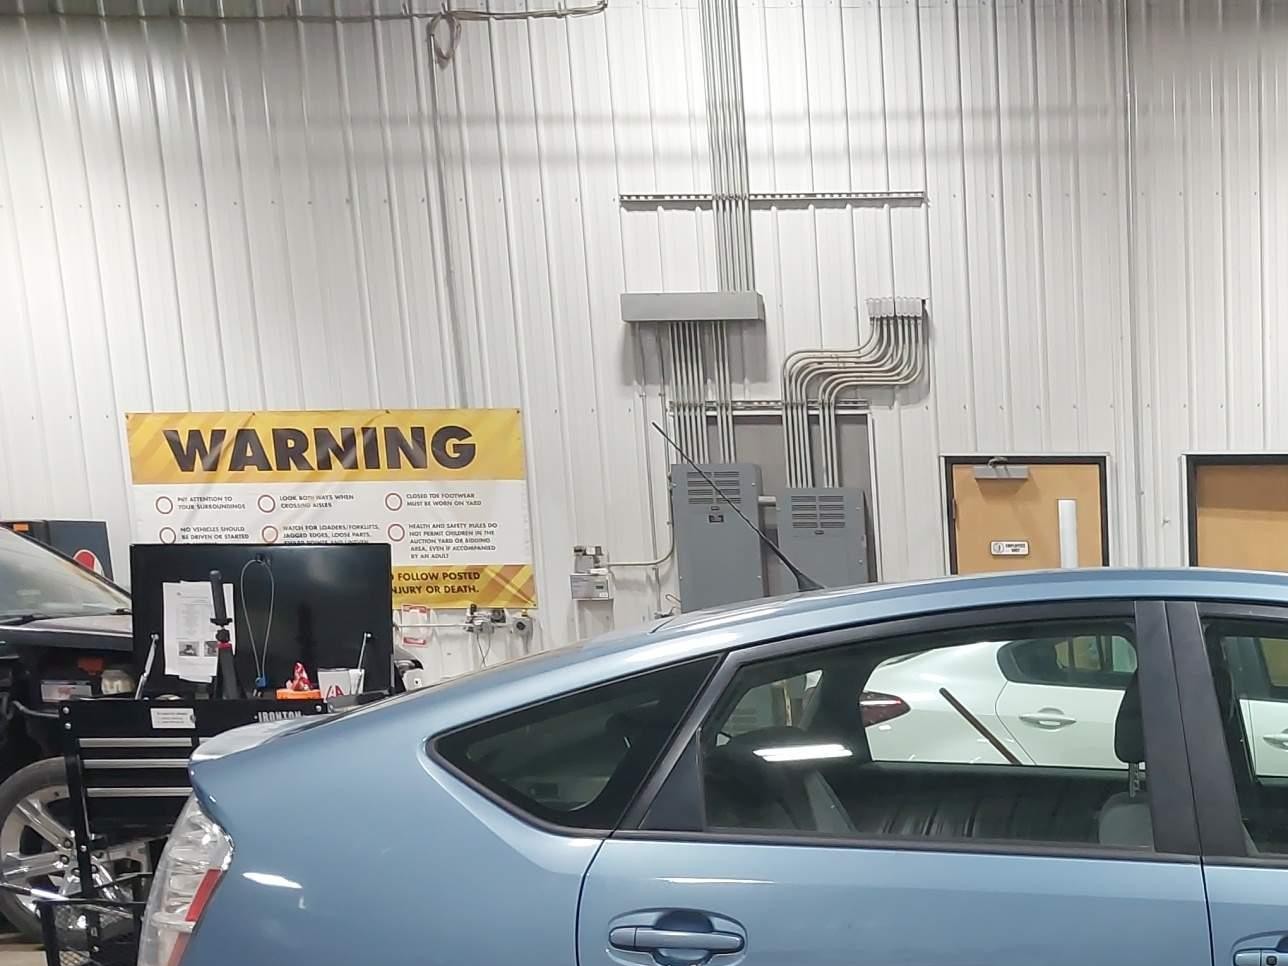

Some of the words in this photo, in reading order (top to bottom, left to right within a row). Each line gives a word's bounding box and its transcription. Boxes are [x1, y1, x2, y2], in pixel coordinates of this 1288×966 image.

[163, 426, 477, 472] WARNING
[398, 571, 439, 581] FOLLOW
[442, 572, 480, 580] POSTED
[426, 585, 440, 594] OR
[444, 585, 479, 594] DEATH.
